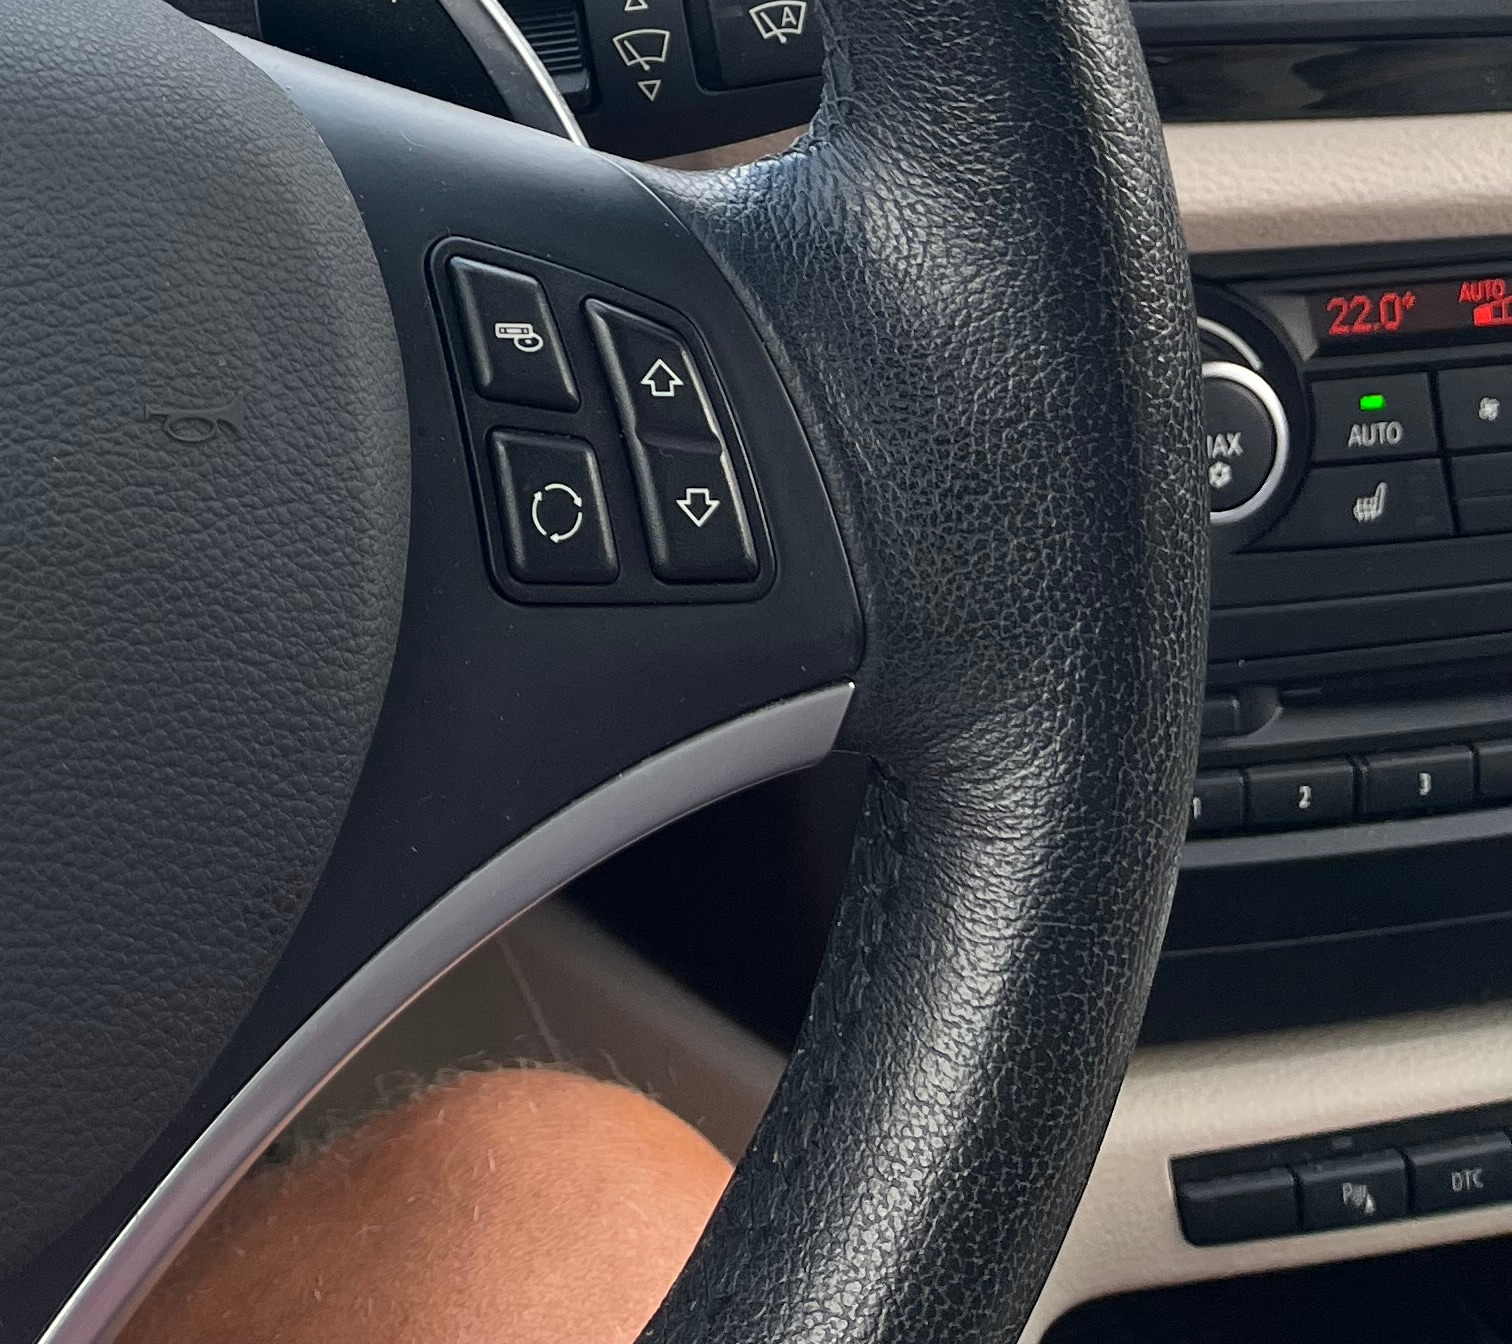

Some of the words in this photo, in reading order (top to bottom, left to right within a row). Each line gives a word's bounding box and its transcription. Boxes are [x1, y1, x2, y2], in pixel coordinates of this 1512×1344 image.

[1459, 278, 1506, 303] AUTO
[1348, 421, 1403, 448] AUTO
[1419, 772, 1433, 796] 3
[1192, 796, 1202, 819] 1
[1299, 785, 1312, 809] 2
[1451, 1168, 1484, 1193] DTC
